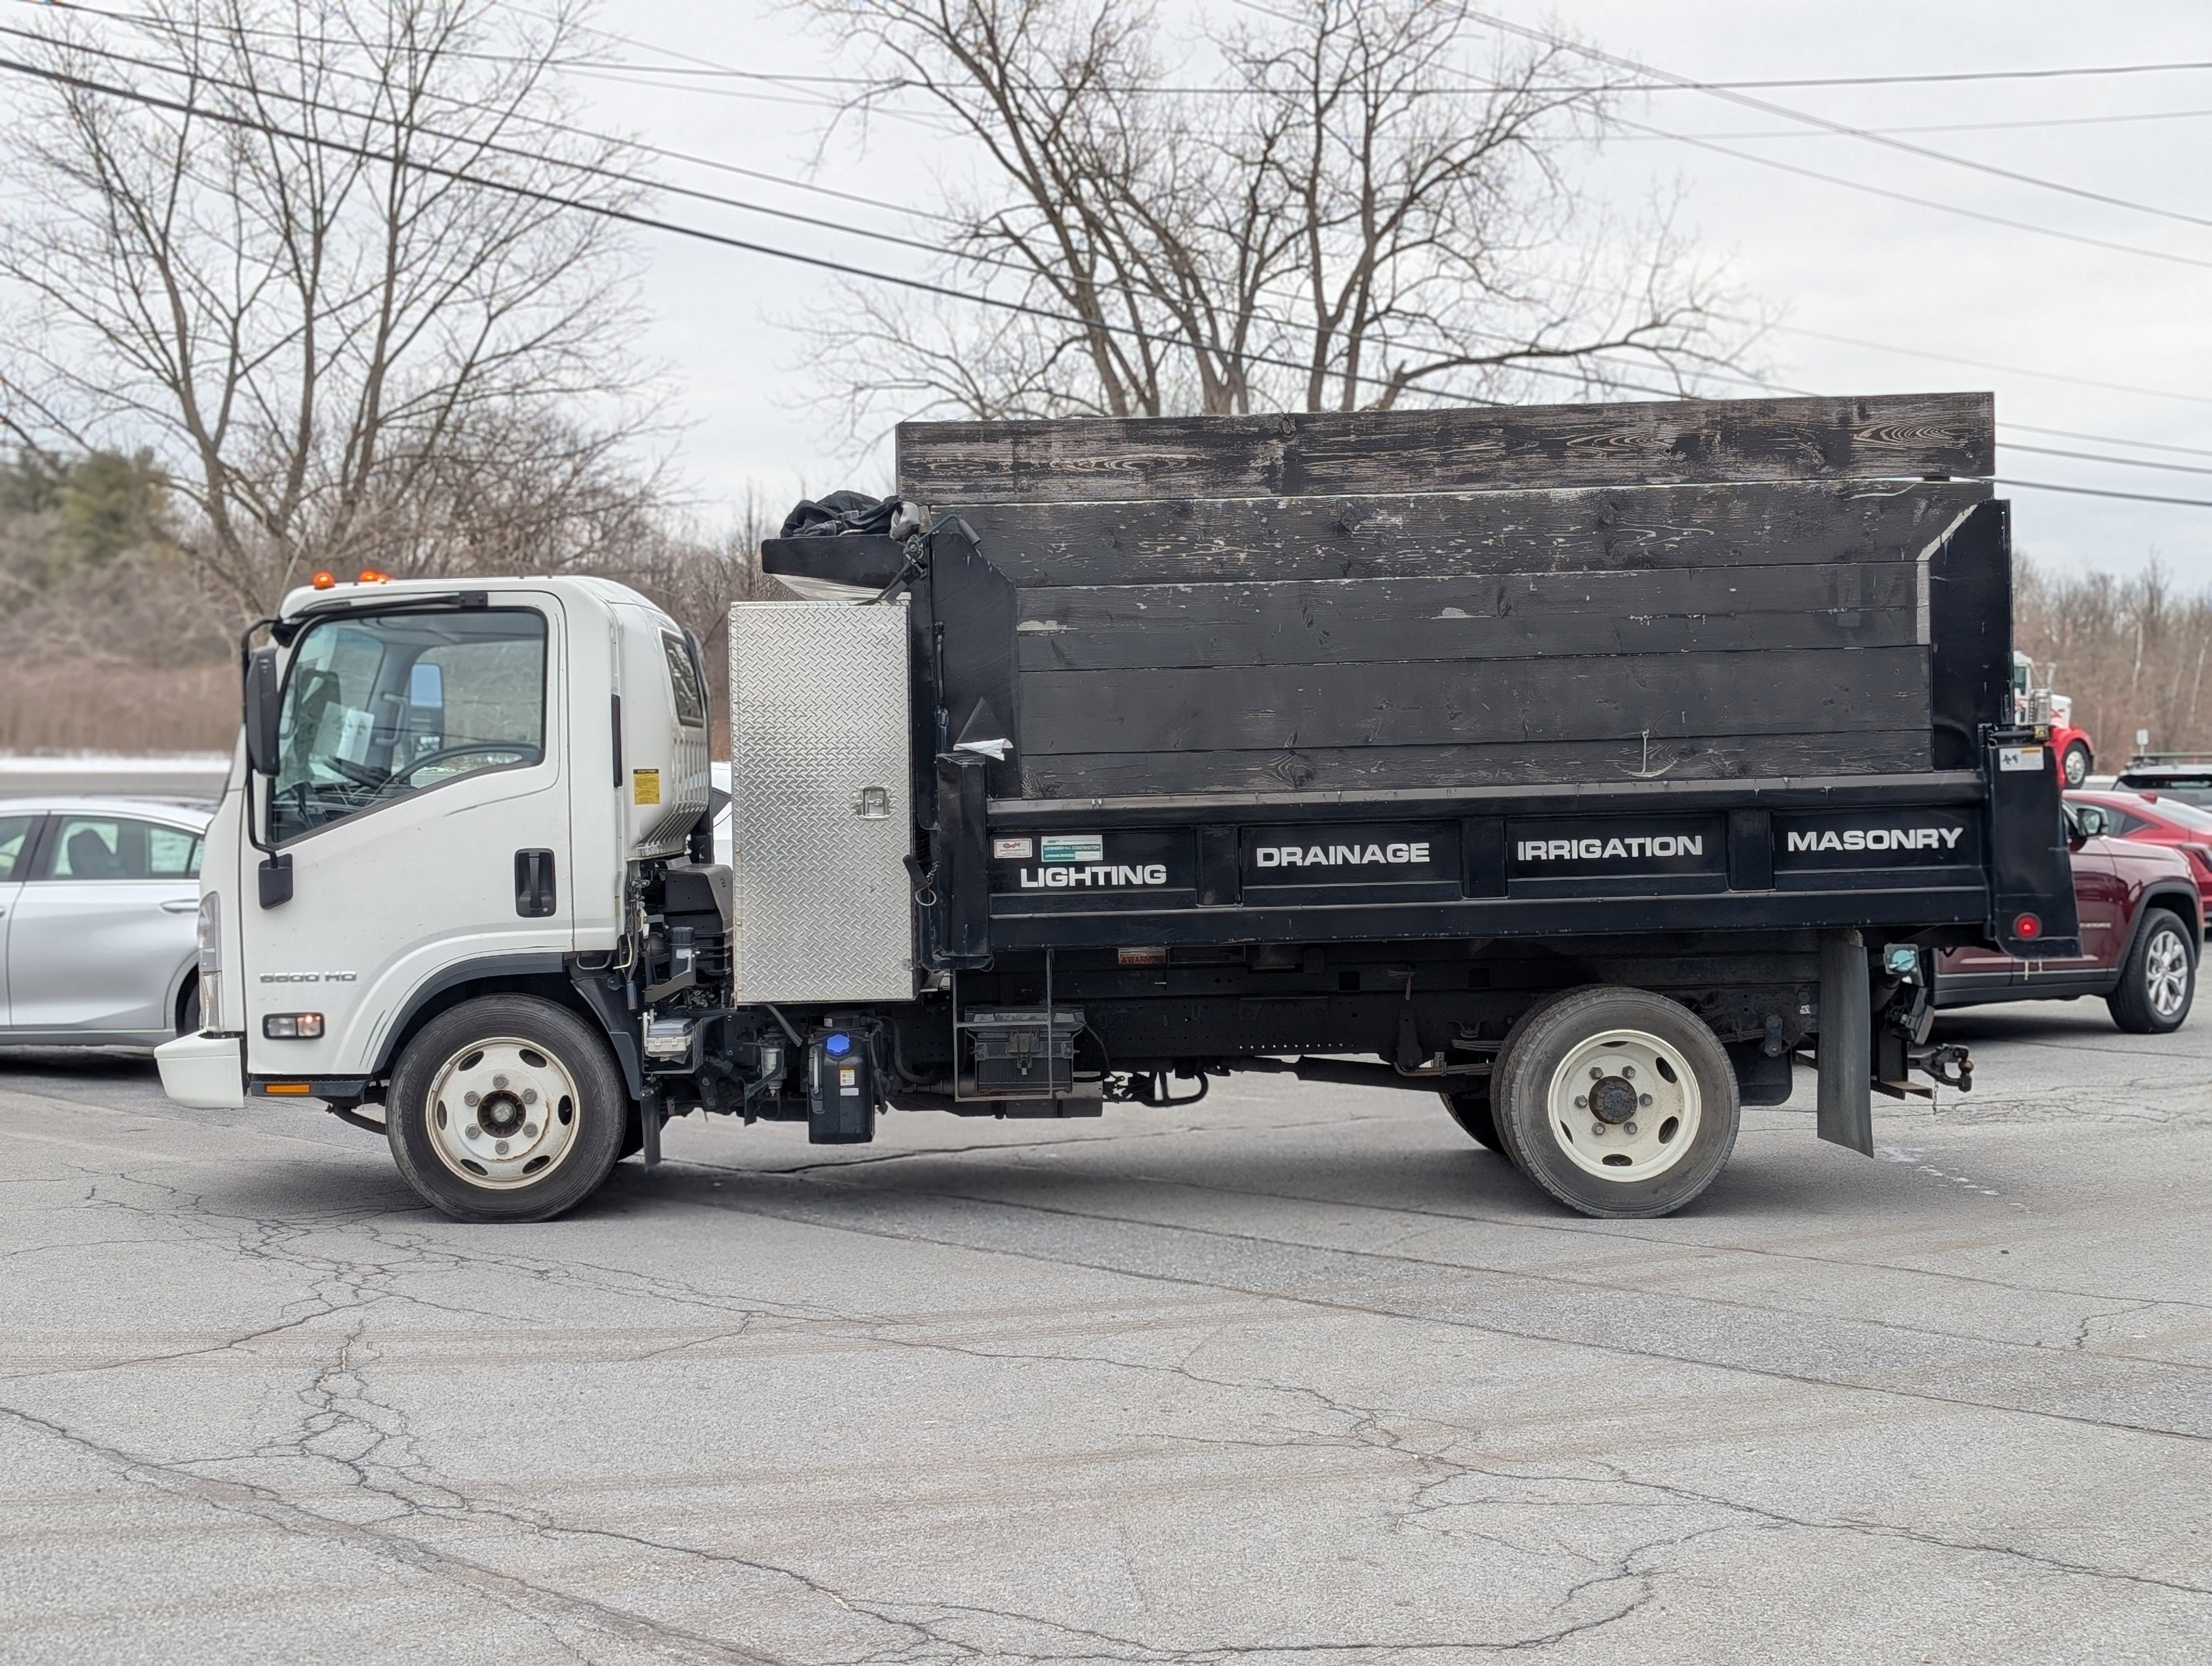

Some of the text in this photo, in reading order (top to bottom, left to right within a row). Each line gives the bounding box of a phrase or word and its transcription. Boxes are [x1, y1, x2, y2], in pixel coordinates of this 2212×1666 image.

[1518, 836, 1702, 860] IRRIGATION
[1789, 828, 1962, 851] MASONRY
[1257, 843, 1430, 867] DRAINAGE
[1021, 864, 1166, 887] LIGHTING
[325, 971, 357, 982] HD
